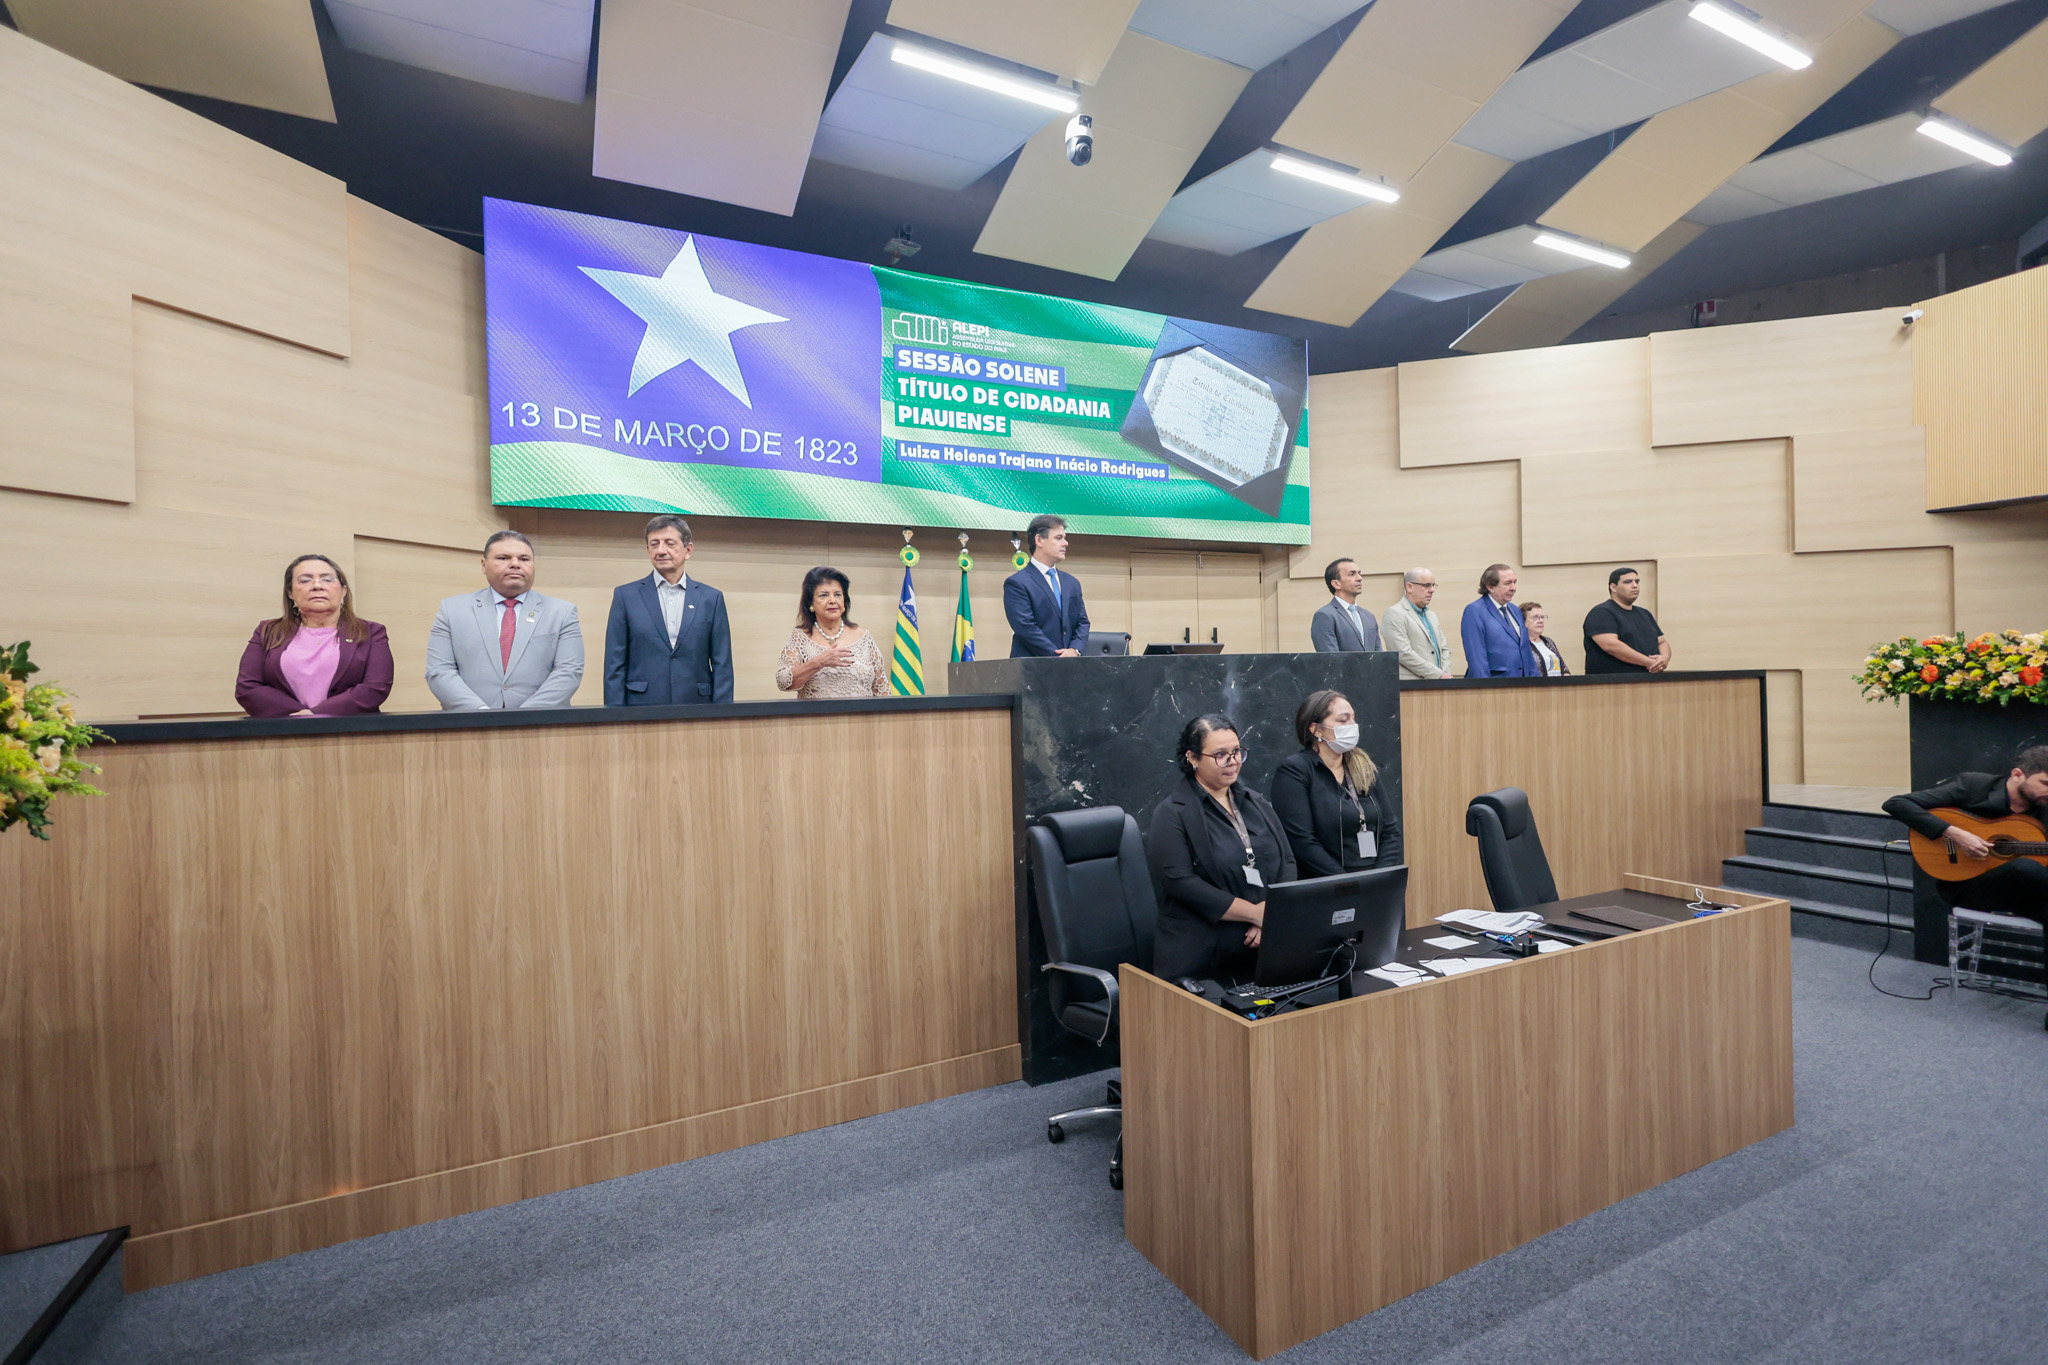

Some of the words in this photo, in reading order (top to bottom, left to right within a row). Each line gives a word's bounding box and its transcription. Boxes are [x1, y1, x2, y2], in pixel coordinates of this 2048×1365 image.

[952, 321, 989, 338] ALEPI
[898, 349, 981, 376] SESSÃO
[985, 361, 1059, 387] SOLENE
[897, 377, 968, 402] TÍTULO
[972, 386, 999, 406] DE
[1003, 390, 1111, 419] CIDADANIA
[502, 401, 541, 428] 13
[553, 406, 602, 438] DE
[614, 418, 730, 455] MARÇO
[740, 428, 782, 456] DE
[794, 436, 859, 466] 1823
[898, 405, 1006, 433] PIAUIENSE
[900, 443, 940, 460] Luiza
[943, 447, 996, 464] Helena
[999, 452, 1053, 470] Trajano
[1055, 456, 1098, 473] Inácio
[1100, 461, 1166, 479] Rodrigues
